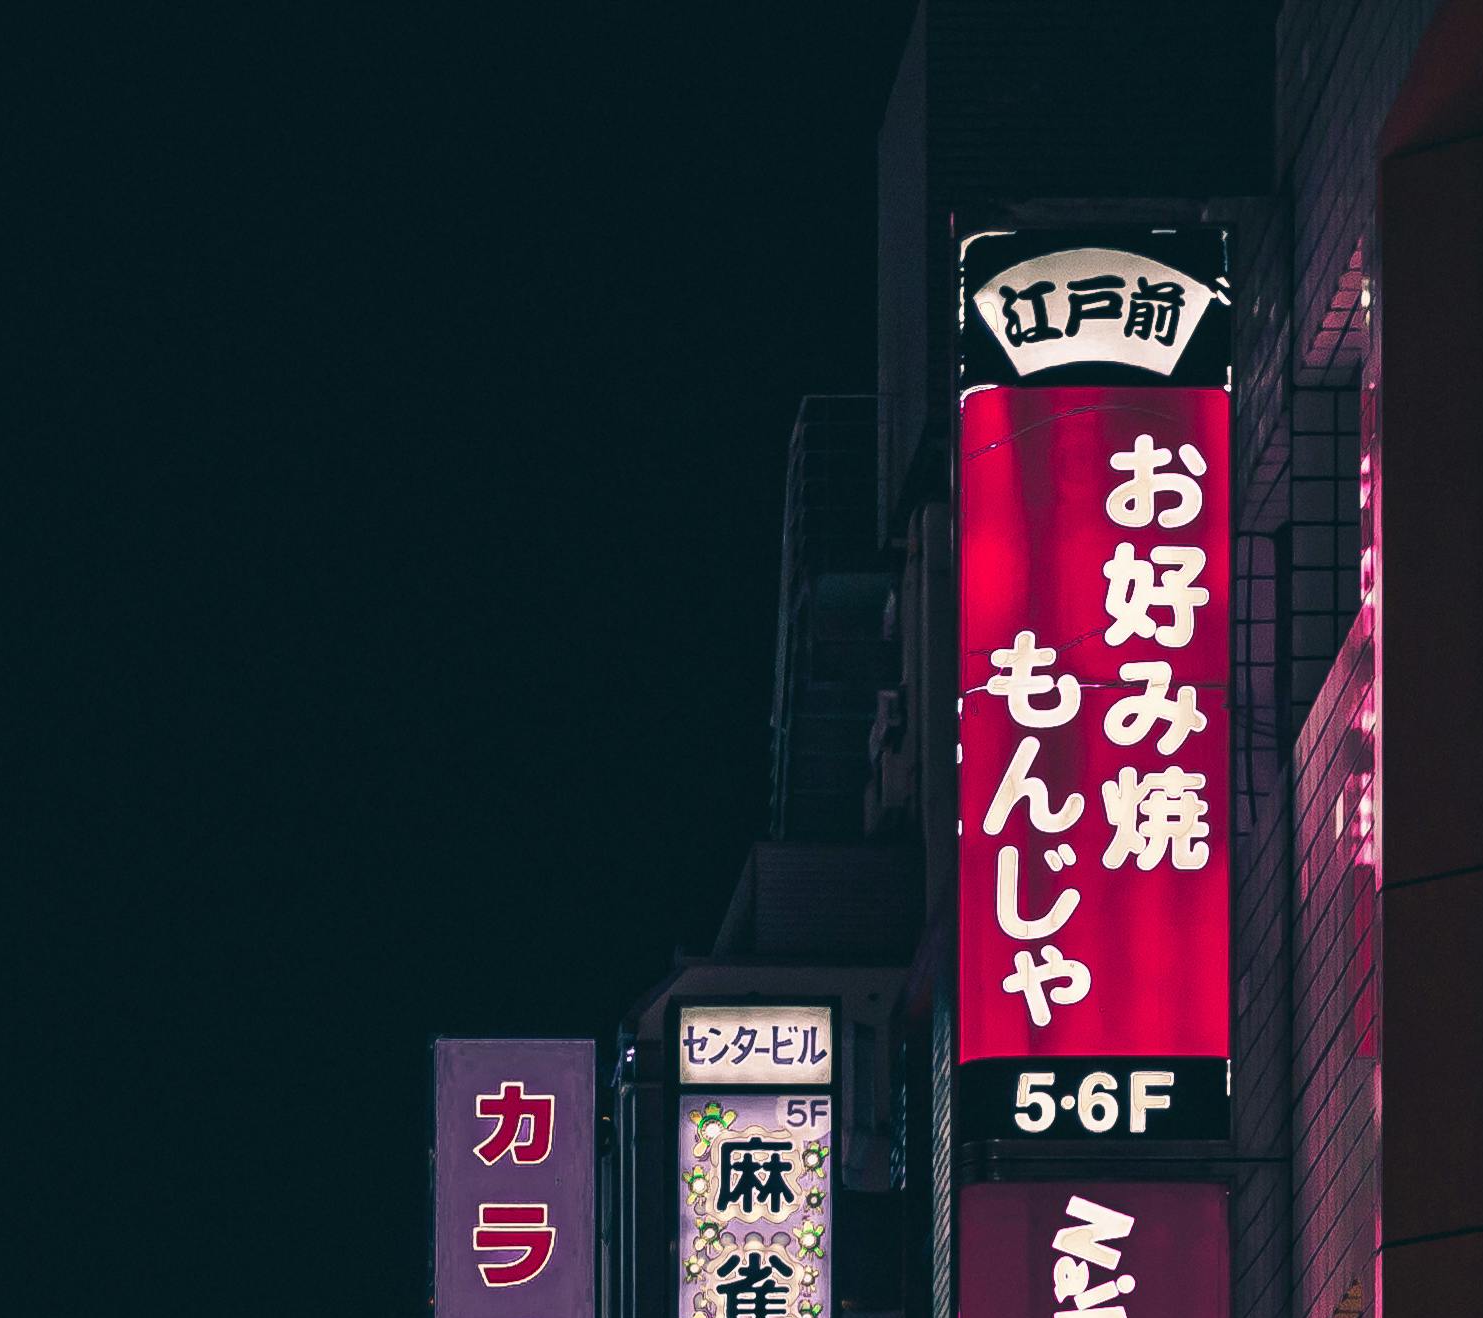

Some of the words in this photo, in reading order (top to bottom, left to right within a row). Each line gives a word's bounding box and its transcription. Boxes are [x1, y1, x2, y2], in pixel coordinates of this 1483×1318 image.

[999, 271, 1186, 349] 江戸前
[1100, 432, 1210, 873] お好み焼
[983, 629, 1093, 1029] もんじゃ
[682, 1024, 829, 1069] センタービル
[785, 1099, 829, 1126] 5F
